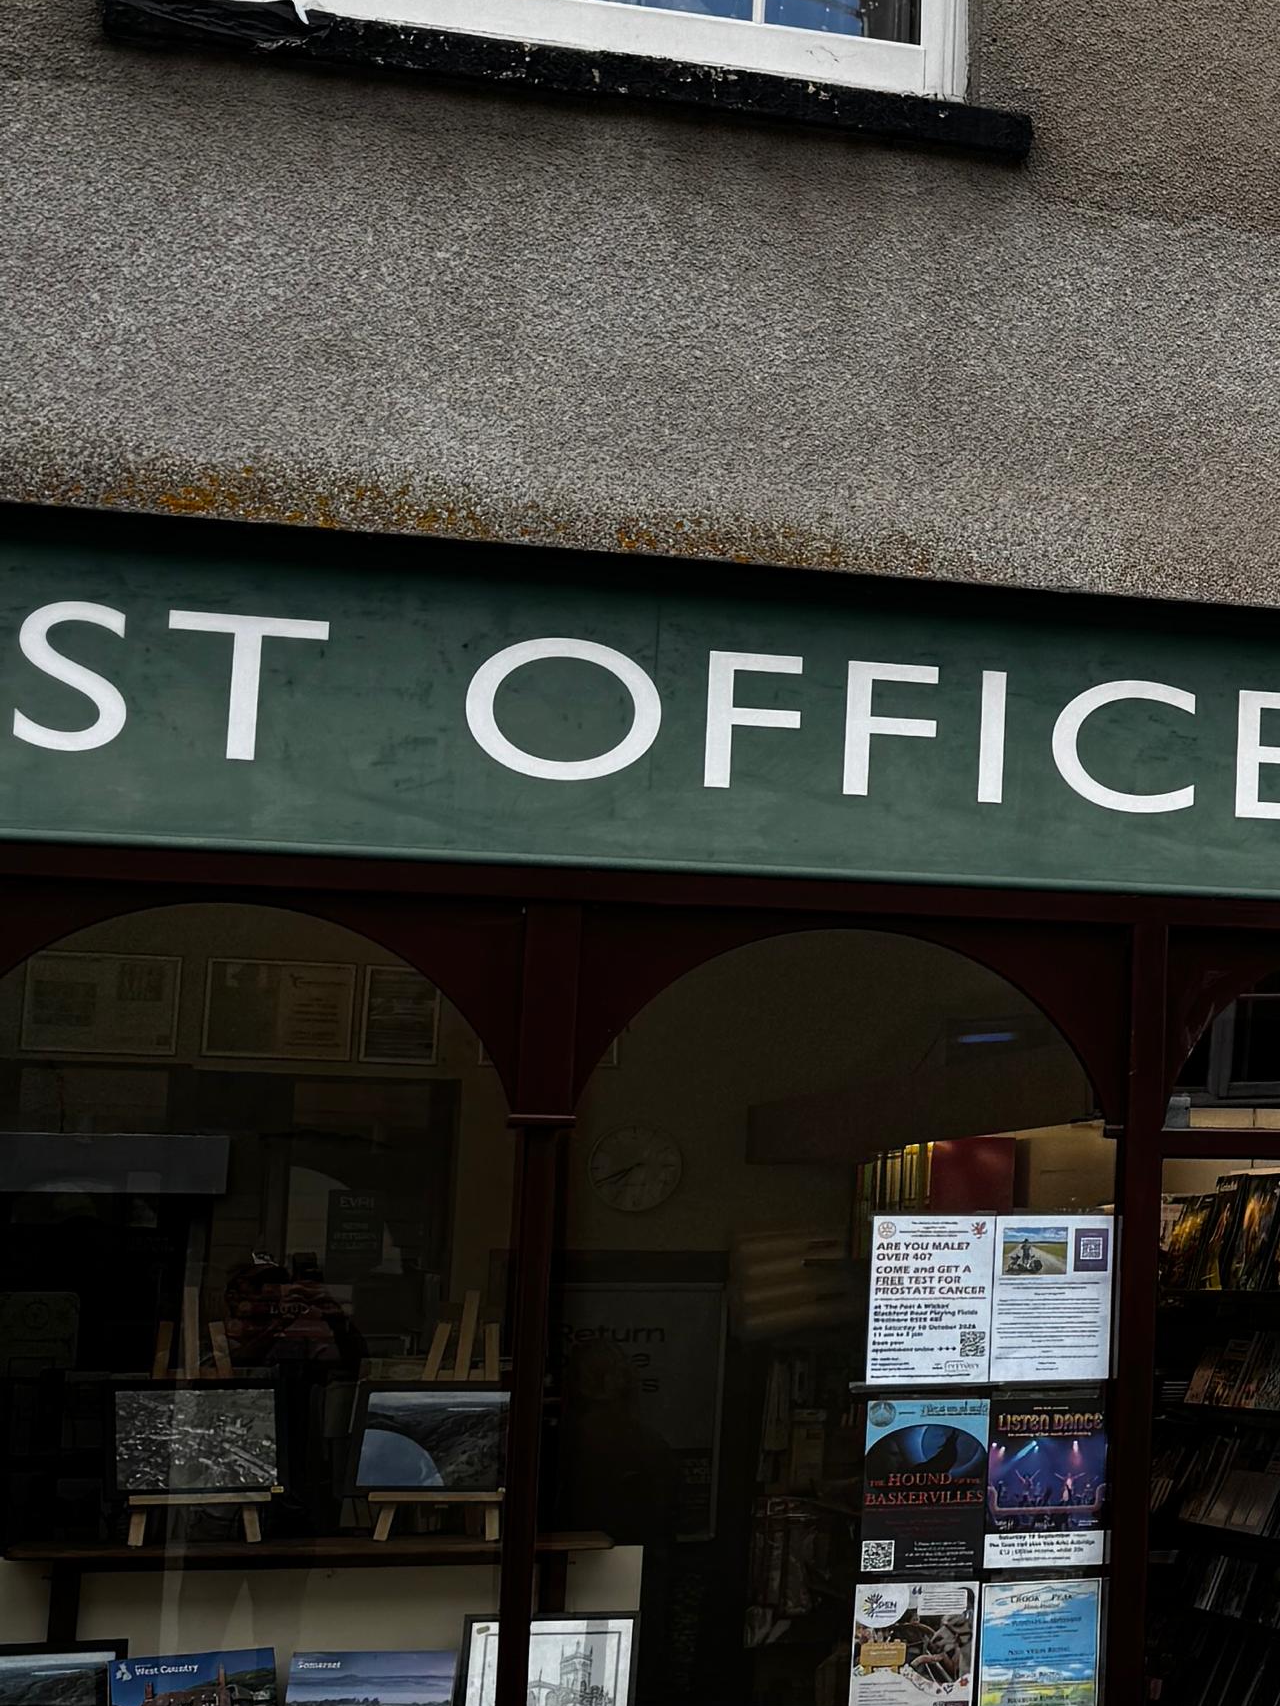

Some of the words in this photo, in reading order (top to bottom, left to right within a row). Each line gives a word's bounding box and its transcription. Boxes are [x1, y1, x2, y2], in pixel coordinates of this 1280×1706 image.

[13, 600, 330, 761] ST
[876, 1242, 901, 1250] ARE
[904, 1242, 929, 1250] YOU
[932, 1241, 970, 1250] MALE?
[876, 1253, 909, 1261] OVER
[912, 1253, 932, 1261] 40?
[875, 1266, 910, 1274] COME
[938, 1265, 960, 1273] GET
[962, 1265, 971, 1273] A
[875, 1276, 904, 1285] FREE
[908, 1276, 935, 1284] TEST
[938, 1275, 961, 1284] FOR
[875, 1287, 936, 1295] PROSTATE
[939, 1286, 985, 1294] CANCER
[888, 1473, 951, 1487] HOUND
[864, 1490, 984, 1505] BASKERVILLES
[134, 1667, 160, 1676] West
[160, 1664, 199, 1674] Country
[297, 1661, 342, 1670] Somerset
